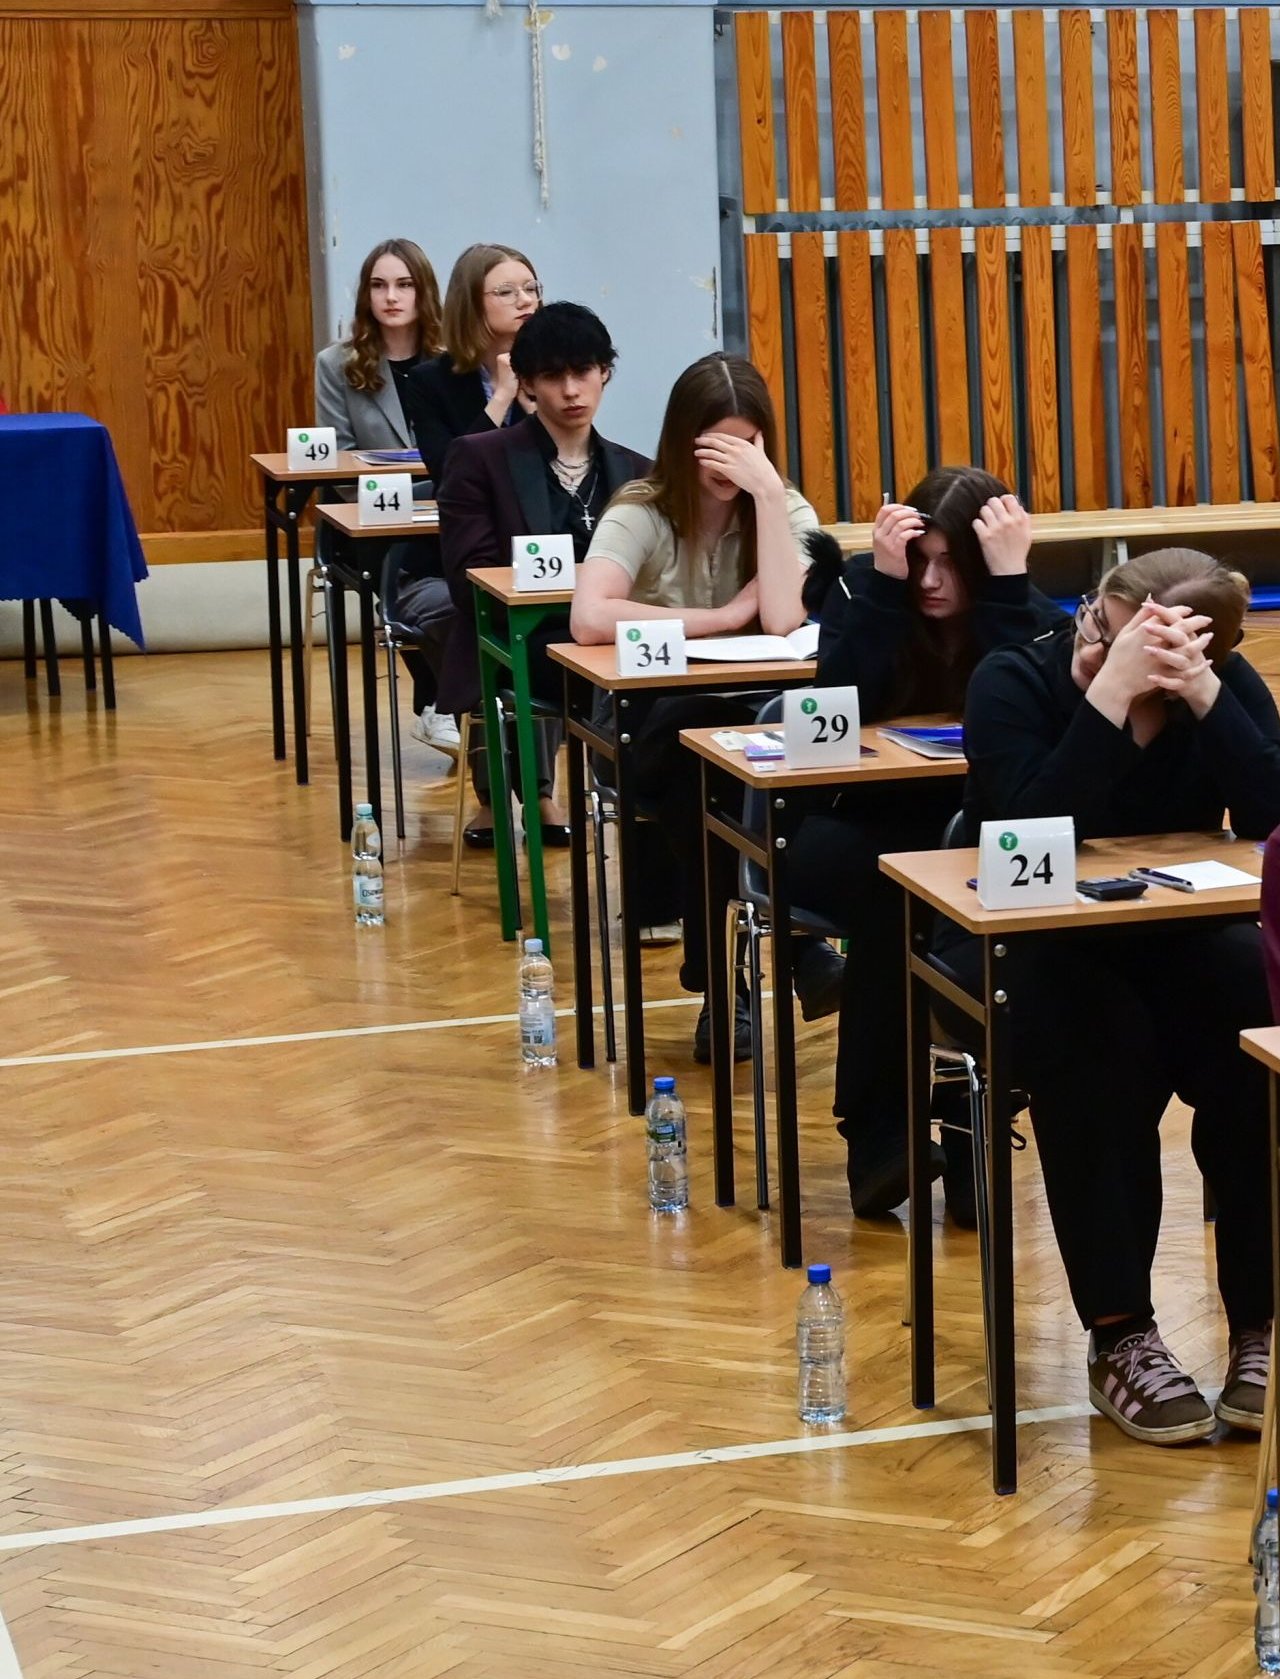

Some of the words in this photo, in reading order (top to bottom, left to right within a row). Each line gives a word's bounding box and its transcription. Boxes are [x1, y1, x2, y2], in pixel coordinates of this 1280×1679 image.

[304, 442, 330, 461] 49
[373, 491, 401, 512] 44
[533, 556, 563, 579] 39
[636, 641, 671, 668] 34
[811, 714, 849, 744] 29
[1010, 852, 1054, 887] 24
